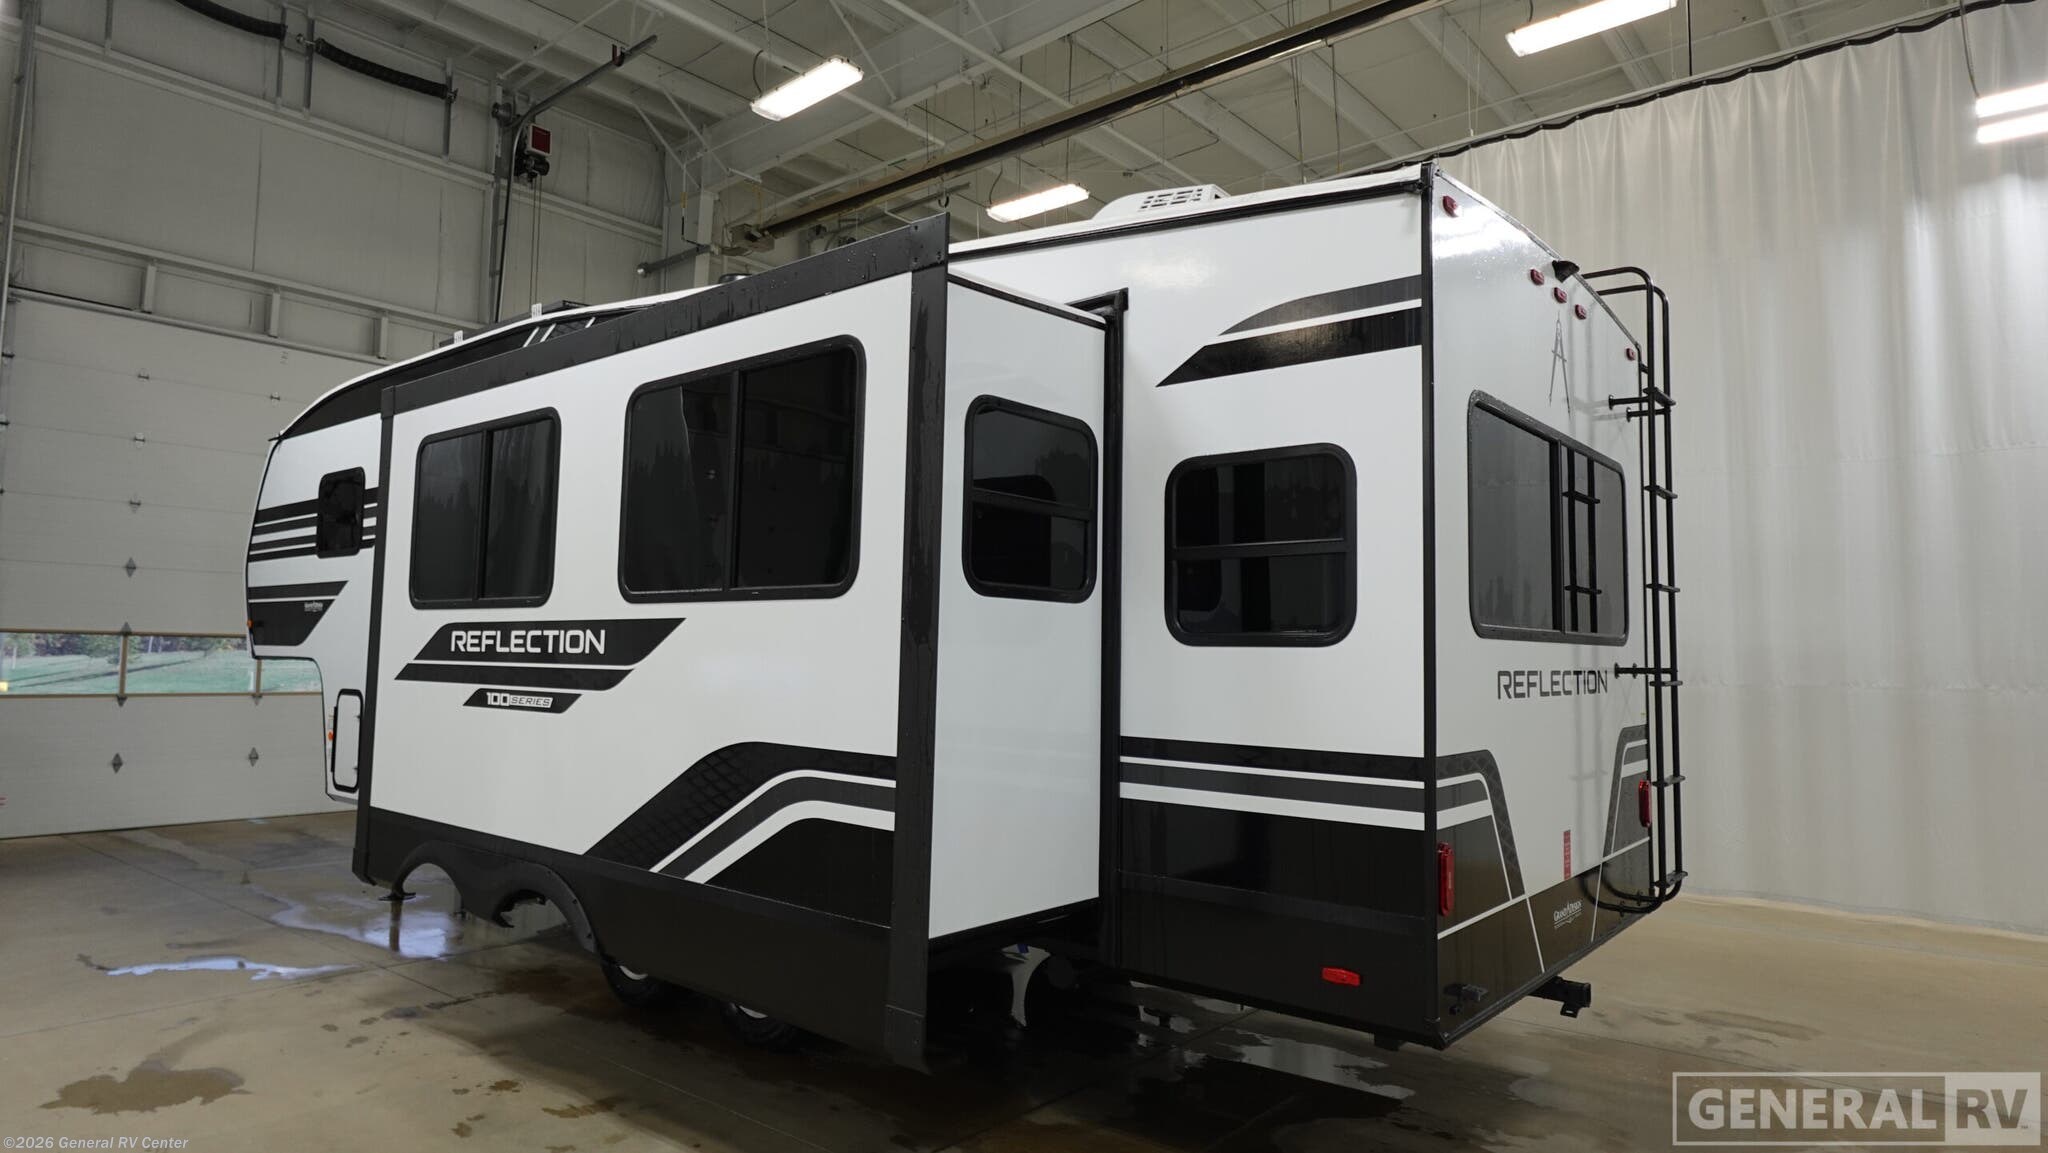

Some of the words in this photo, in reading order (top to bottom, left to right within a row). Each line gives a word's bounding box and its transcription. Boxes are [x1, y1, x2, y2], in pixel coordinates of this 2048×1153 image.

[450, 629, 606, 655] REFLECTION
[1497, 670, 1608, 700] REFLECTION
[486, 692, 510, 707] 100
[511, 696, 552, 707] SERIES
